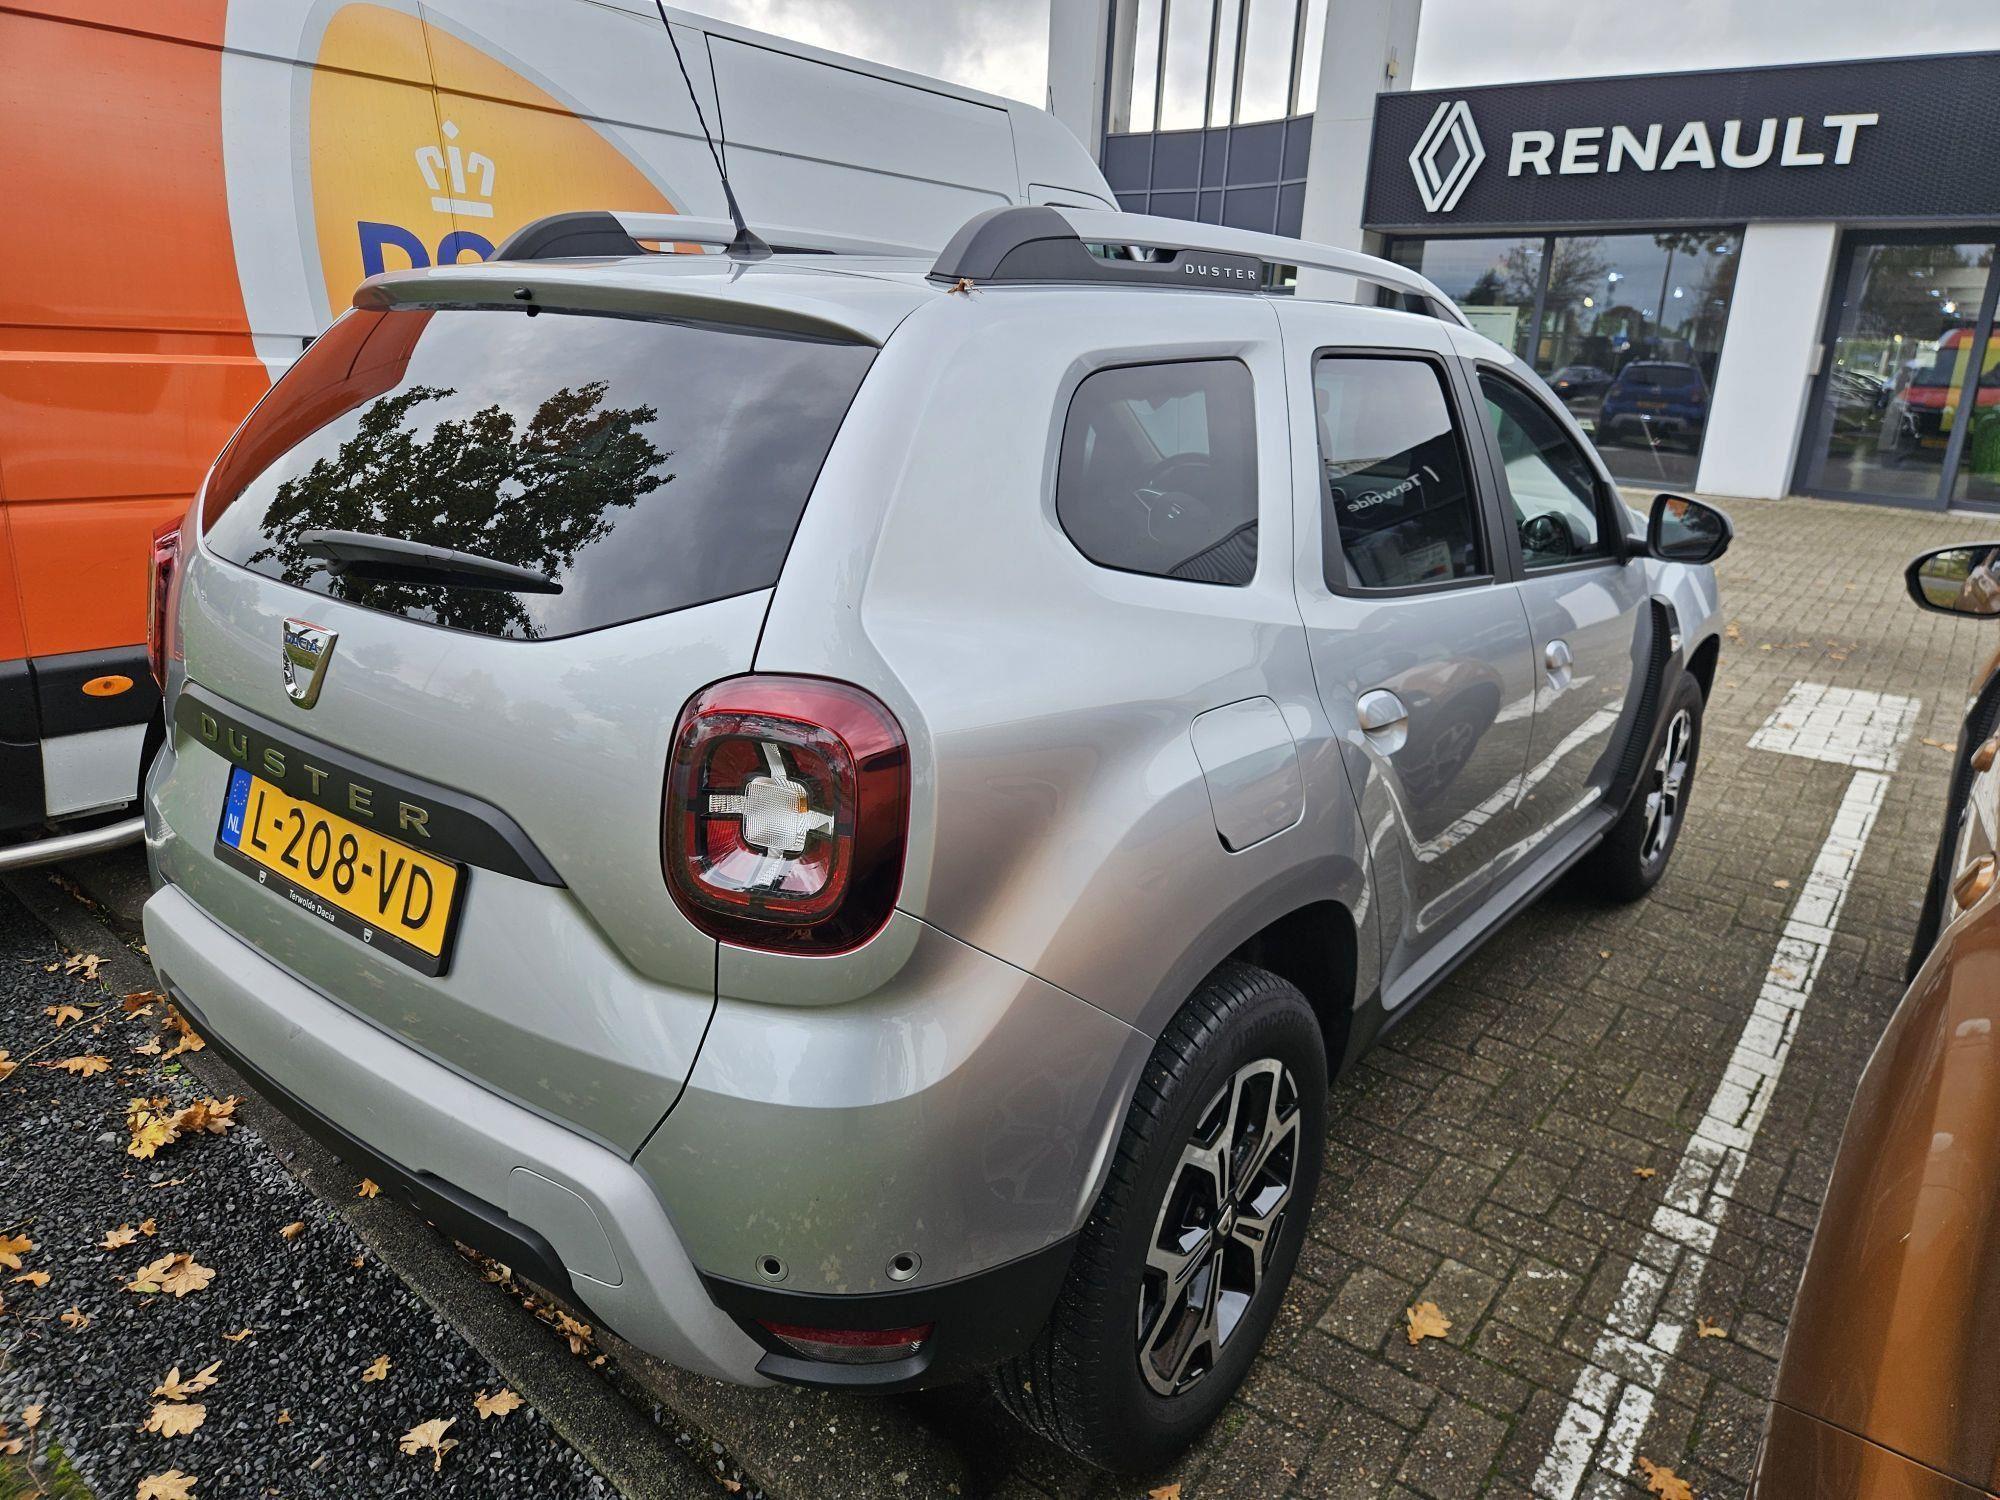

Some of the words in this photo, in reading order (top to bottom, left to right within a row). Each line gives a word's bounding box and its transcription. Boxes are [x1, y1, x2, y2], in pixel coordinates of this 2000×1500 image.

[1507, 113, 1879, 177] RENAULT
[1185, 264, 1256, 280] DUSTER
[201, 712, 431, 838] DUSTER
[227, 813, 240, 835] NL
[252, 790, 433, 930] L-208-VD
[289, 889, 316, 911] Terwolde
[316, 905, 335, 922] Dacia
